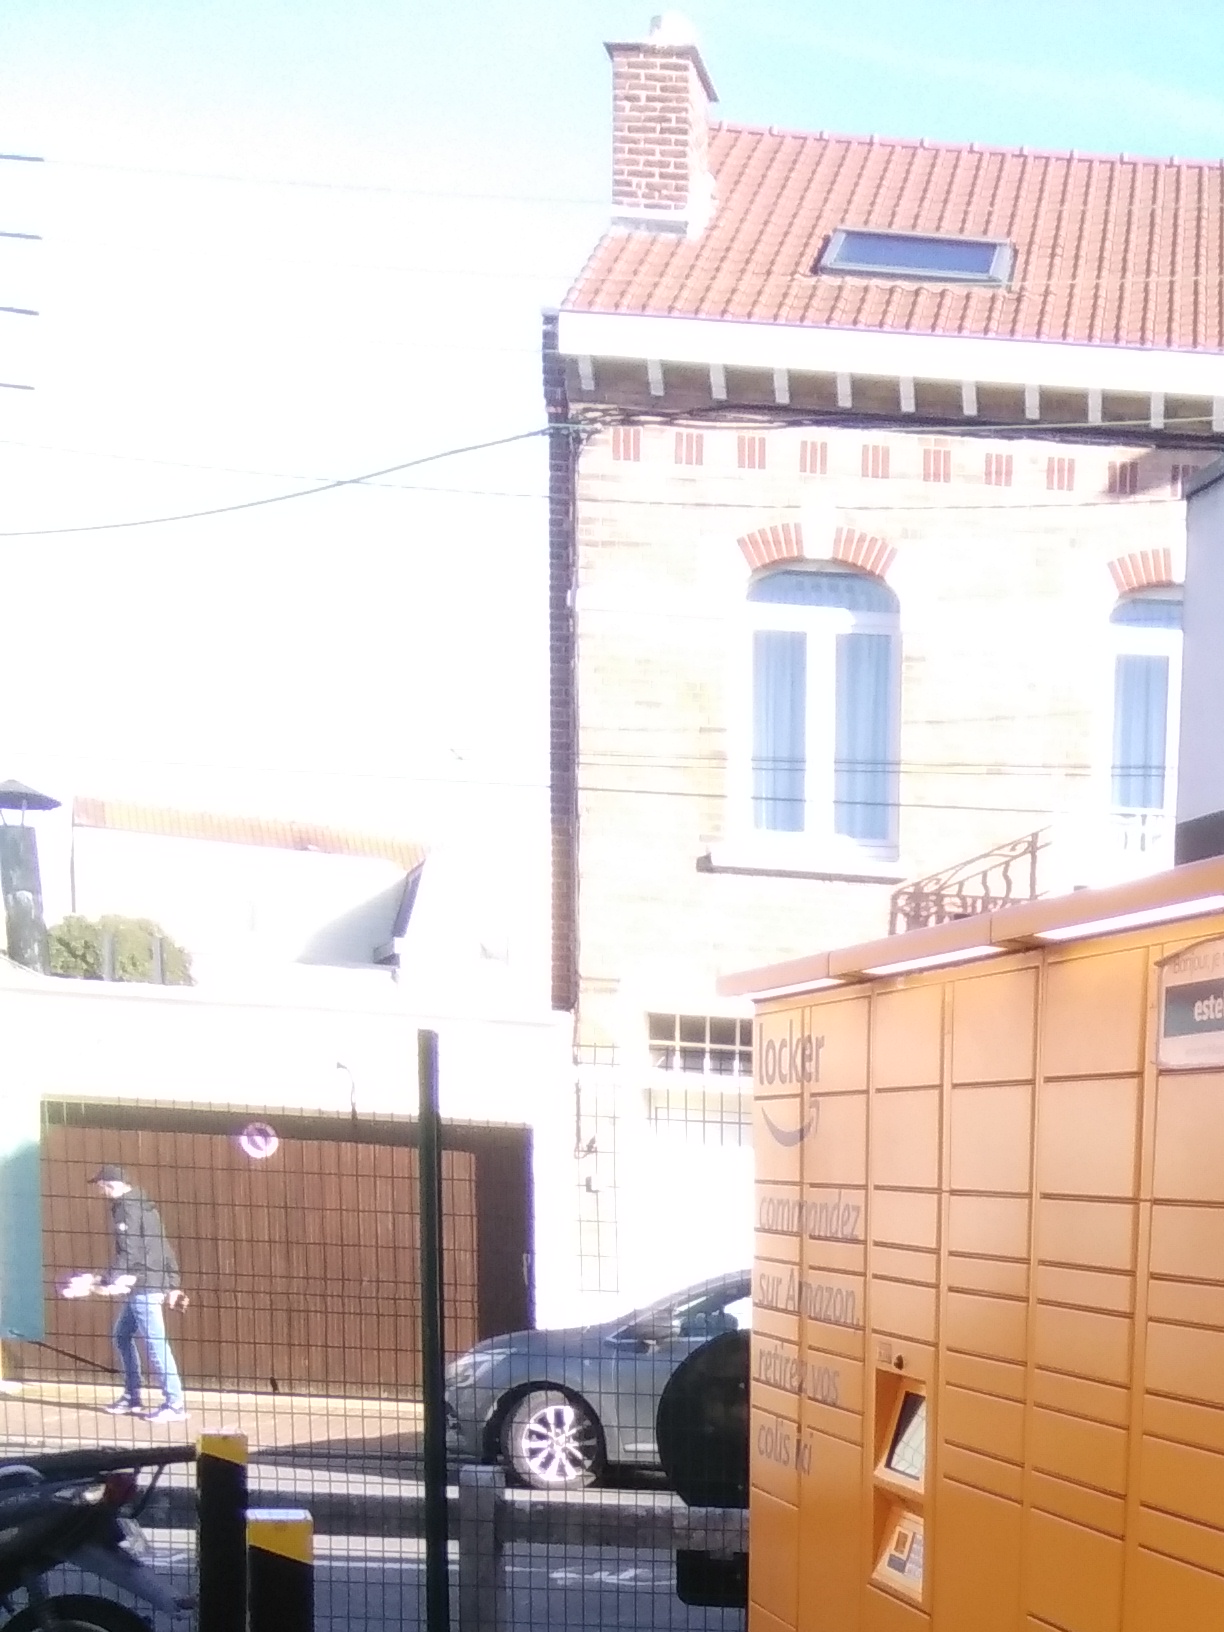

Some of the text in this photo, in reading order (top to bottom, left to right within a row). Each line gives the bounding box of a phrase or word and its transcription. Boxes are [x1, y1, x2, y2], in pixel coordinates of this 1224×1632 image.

[758, 1019, 825, 1086] locker
[759, 1189, 861, 1239] commandez
[759, 1267, 861, 1332] sur Amazon,
[759, 1342, 840, 1404] retirez vos
[757, 1416, 813, 1477] colis ici
